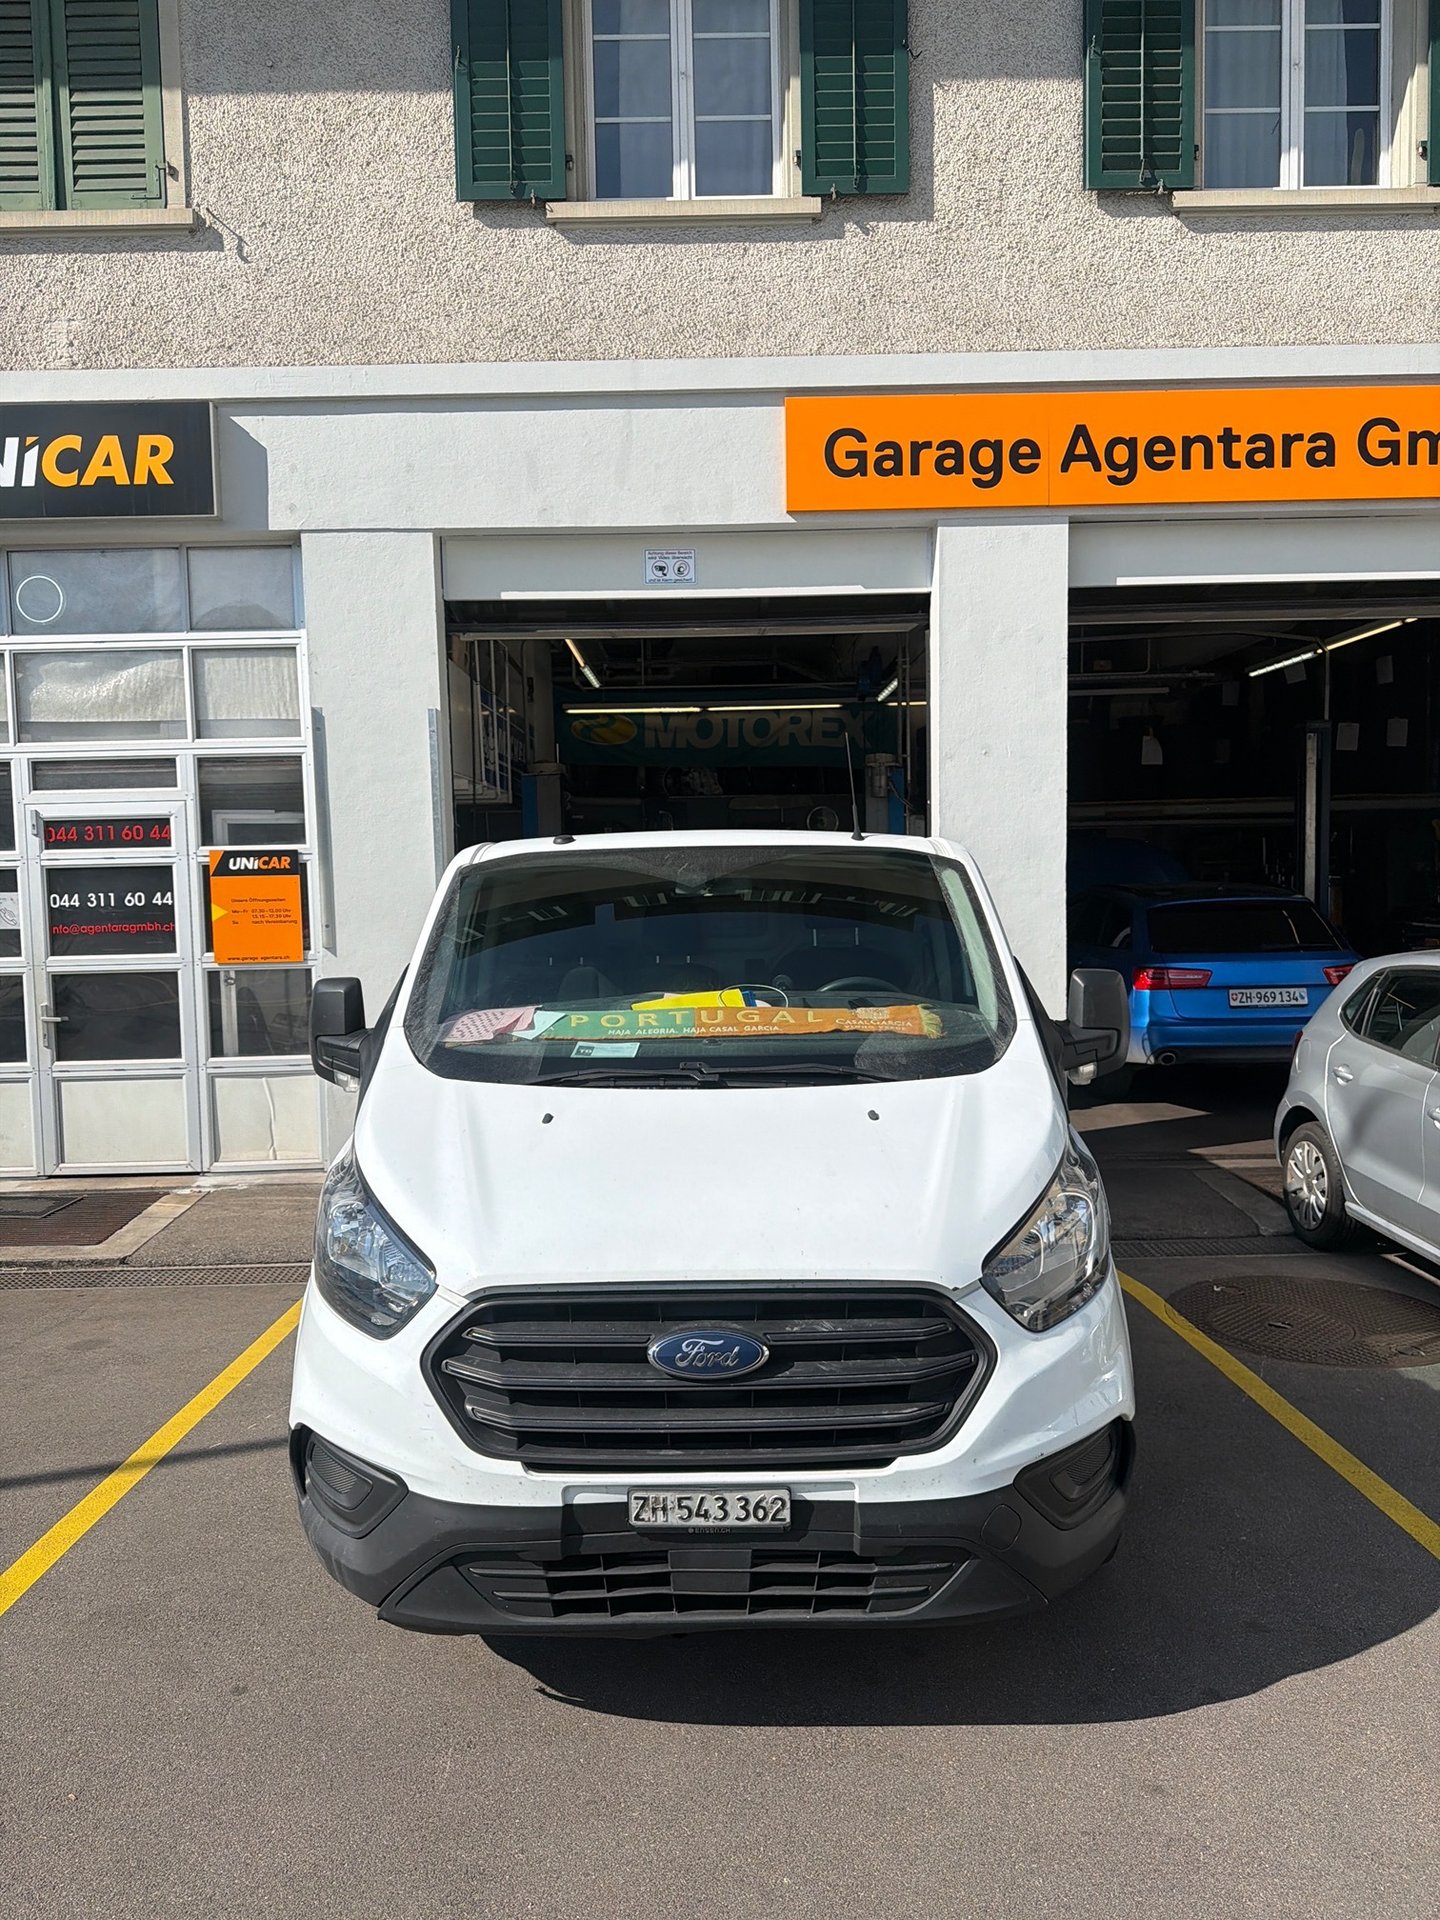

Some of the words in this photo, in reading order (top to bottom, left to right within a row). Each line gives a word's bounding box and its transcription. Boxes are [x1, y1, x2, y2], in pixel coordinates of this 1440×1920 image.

[823, 425, 1041, 490] Garage
[1059, 423, 1337, 487] Agentara
[644, 709, 875, 749] MOTOREX
[84, 825, 115, 840] 311
[121, 825, 144, 840] 60
[150, 824, 171, 840] 44
[50, 893, 80, 908] 044
[87, 892, 115, 907] 311
[124, 892, 146, 907] 60
[152, 891, 173, 906] 44
[570, 1010, 823, 1027] PORTUGAL
[675, 1338, 740, 1368] Ford
